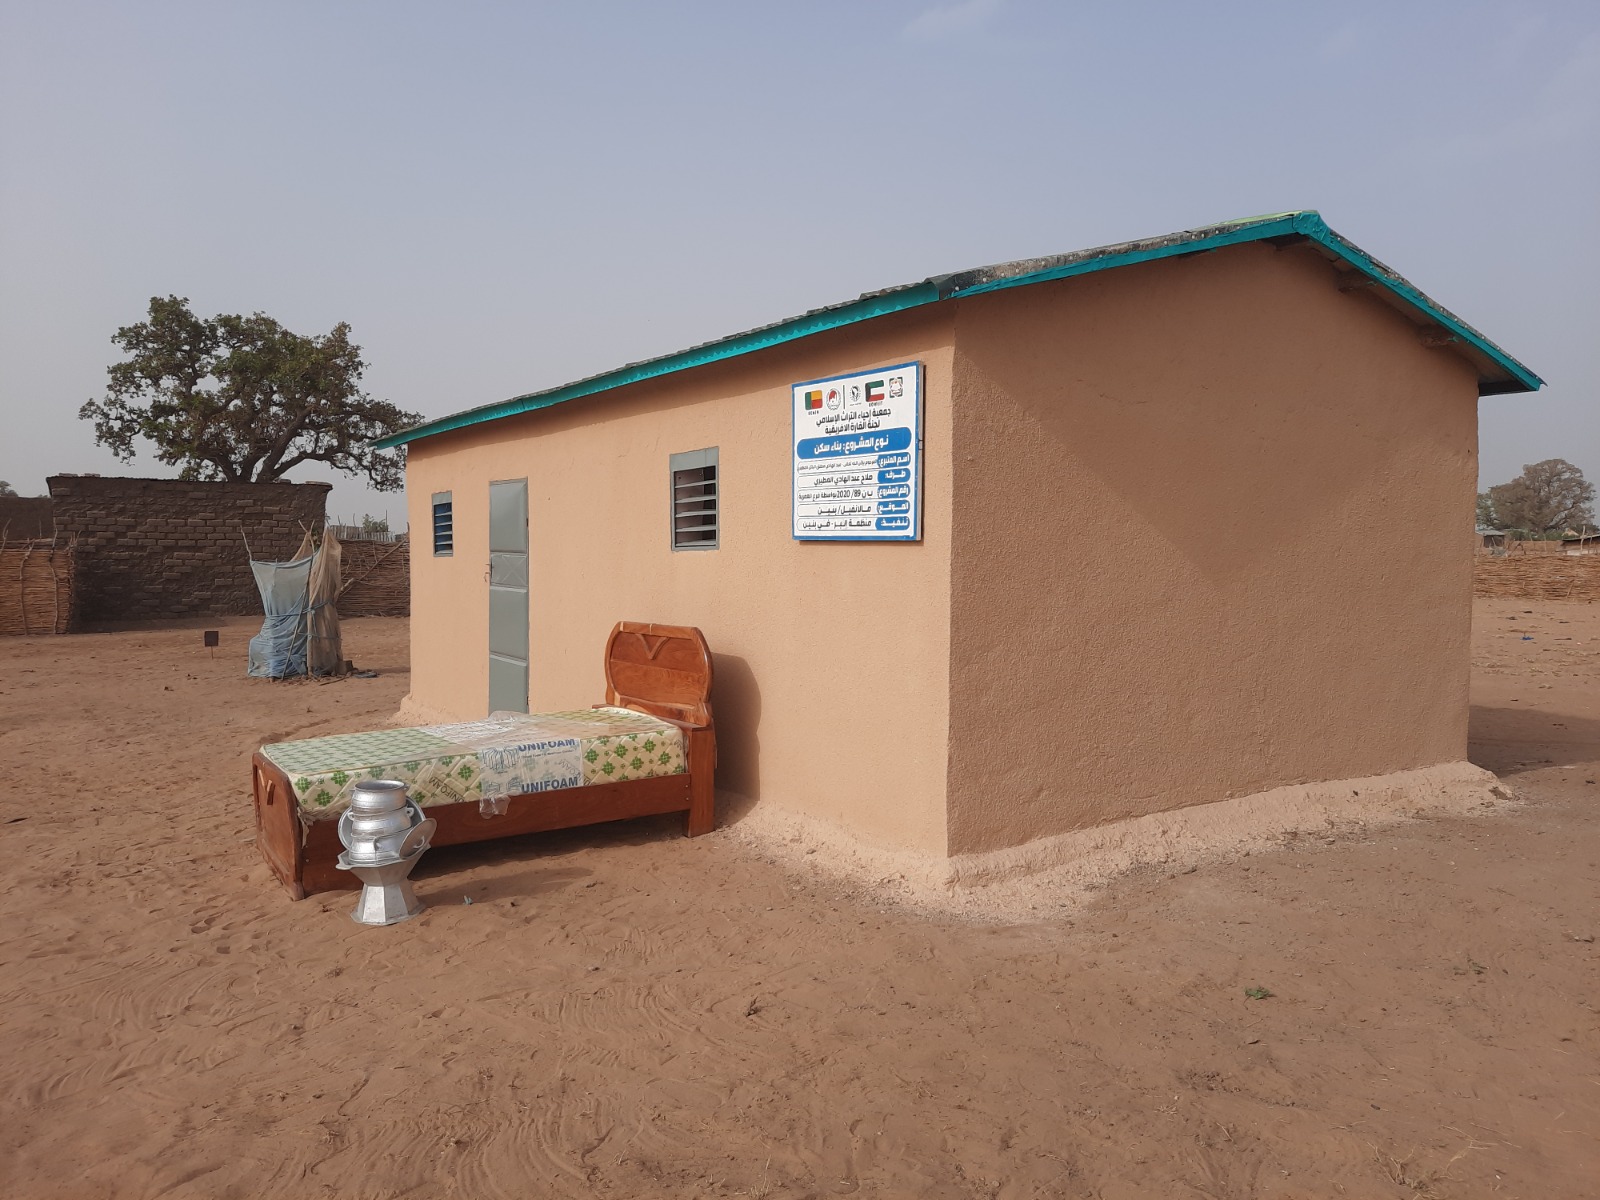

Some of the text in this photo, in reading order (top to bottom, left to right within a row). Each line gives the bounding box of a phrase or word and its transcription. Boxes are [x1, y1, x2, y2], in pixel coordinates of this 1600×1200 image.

[840, 411, 857, 422] التراث
[858, 410, 871, 420] إحياء
[872, 408, 891, 419] جمعية
[851, 422, 867, 433] القارة
[867, 419, 880, 430] لجنة
[831, 441, 842, 452] بناء
[874, 435, 889, 451] نوع
[814, 443, 830, 455] سكن
[814, 476, 833, 487] المطيري
[834, 475, 851, 486] الهادي
[518, 738, 576, 752] UNIFOAM
[521, 776, 578, 794] UNIFOAM
